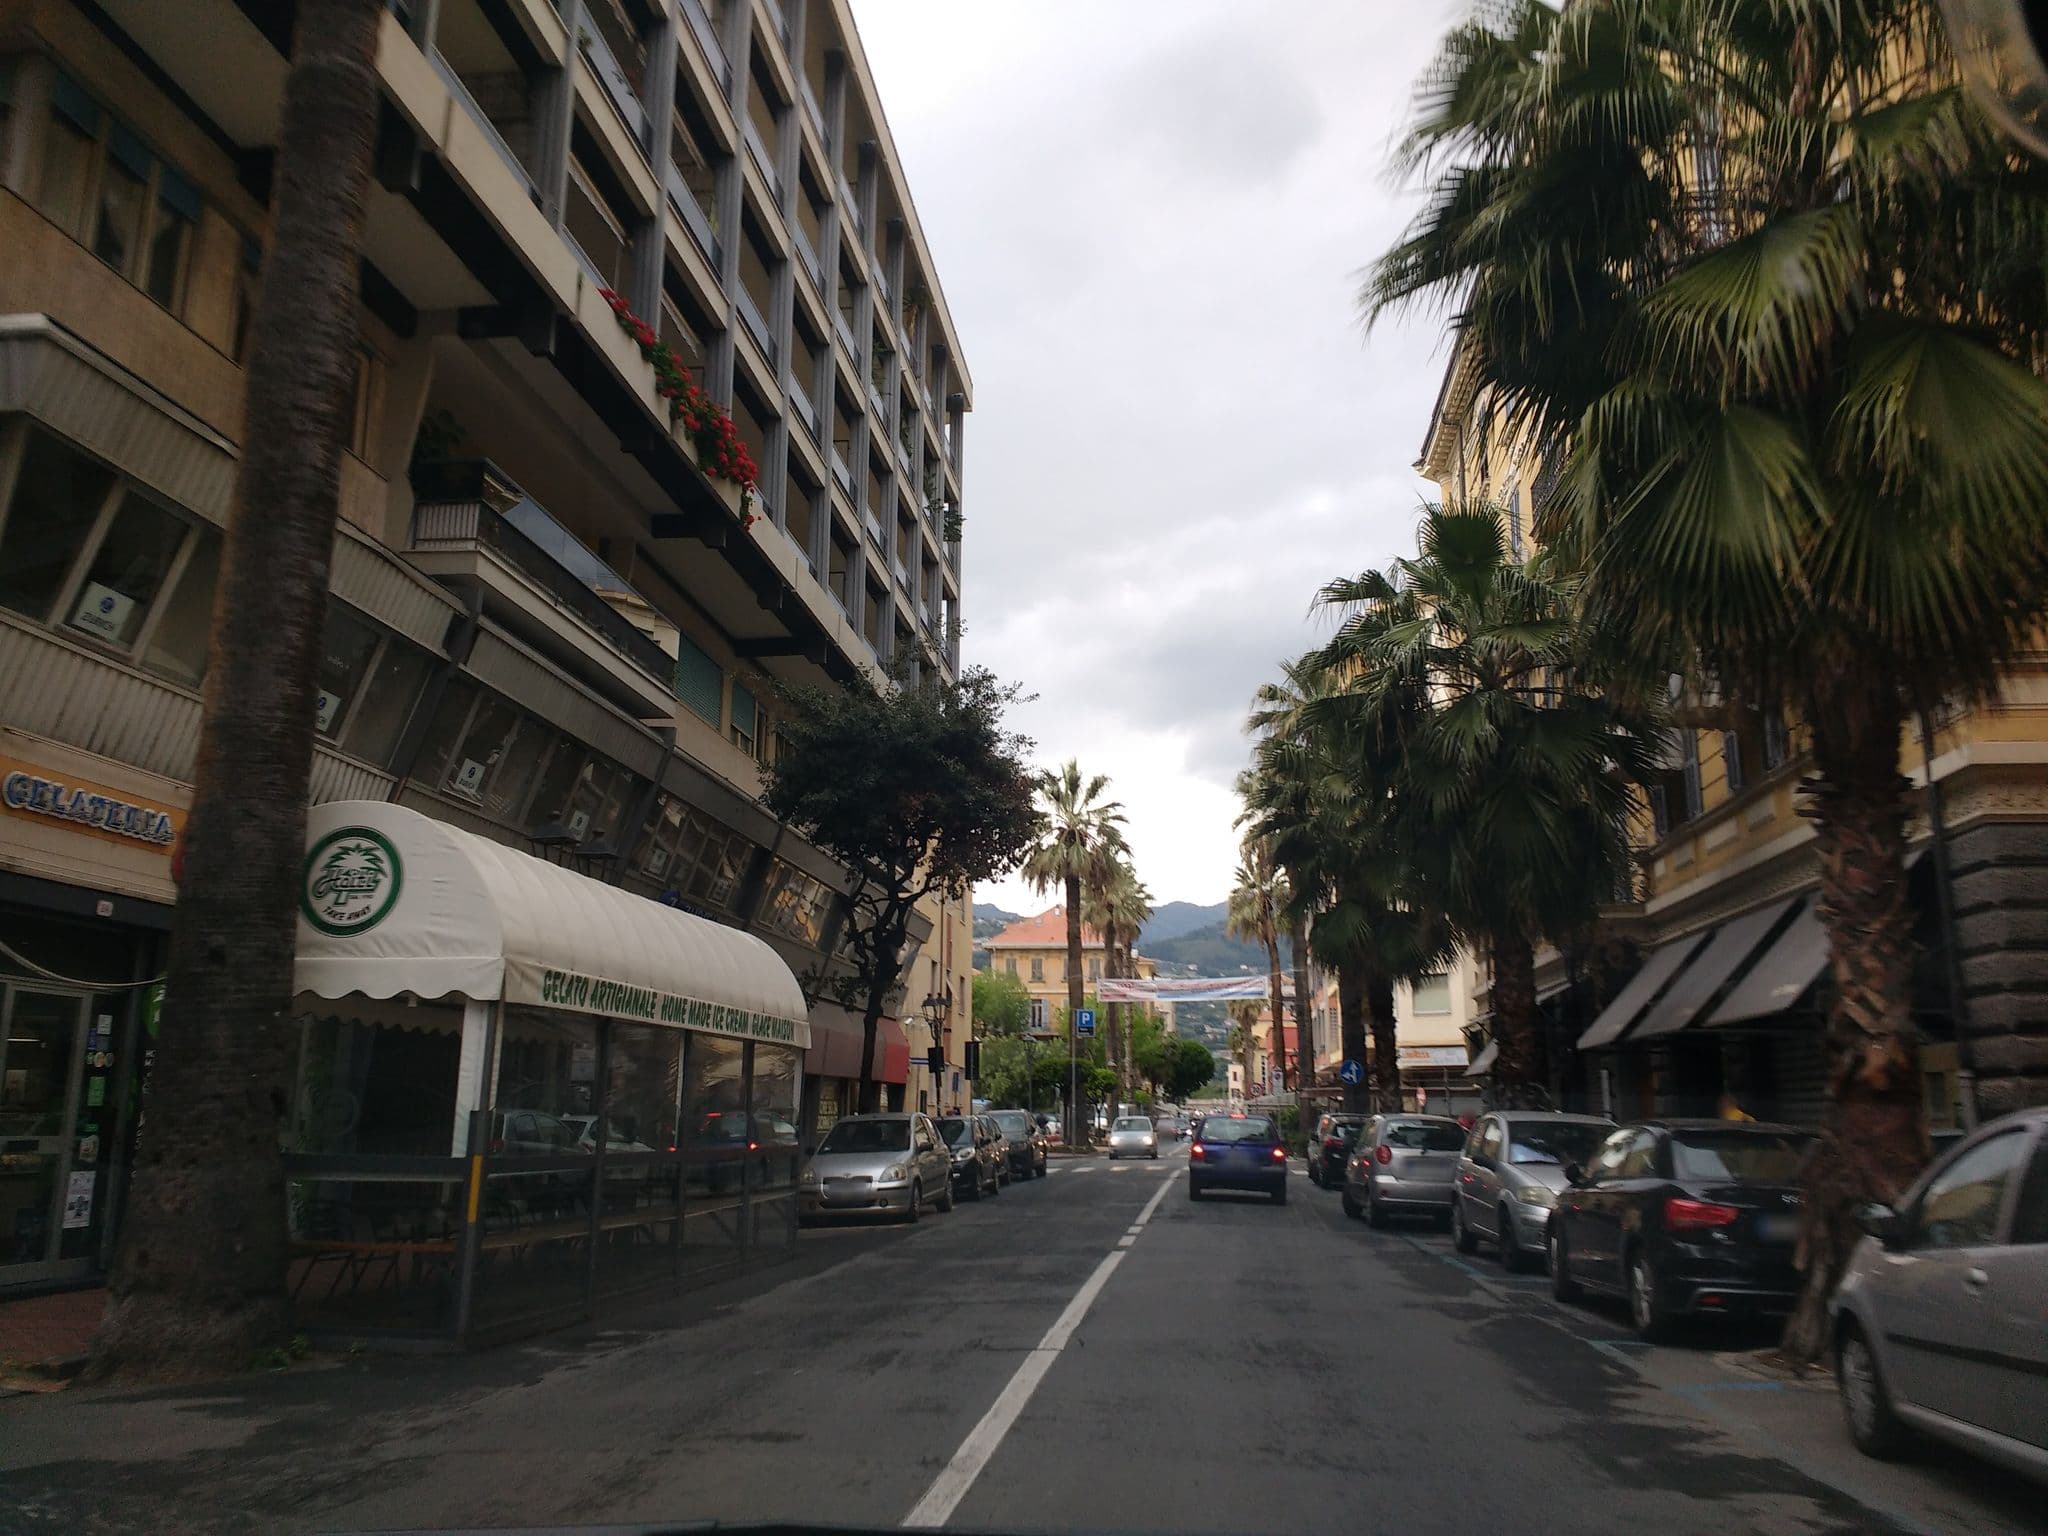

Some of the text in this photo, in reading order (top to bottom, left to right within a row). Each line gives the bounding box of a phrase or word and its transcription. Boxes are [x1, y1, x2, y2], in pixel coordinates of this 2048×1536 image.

[4, 772, 175, 844] GELATERIA
[322, 905, 370, 920] TAKE AWAY
[543, 970, 794, 1041] GELATO ARTIGIANALE HOME MADE ICE CREAM GLACE MAISON
[1082, 1012, 1090, 1024] P
